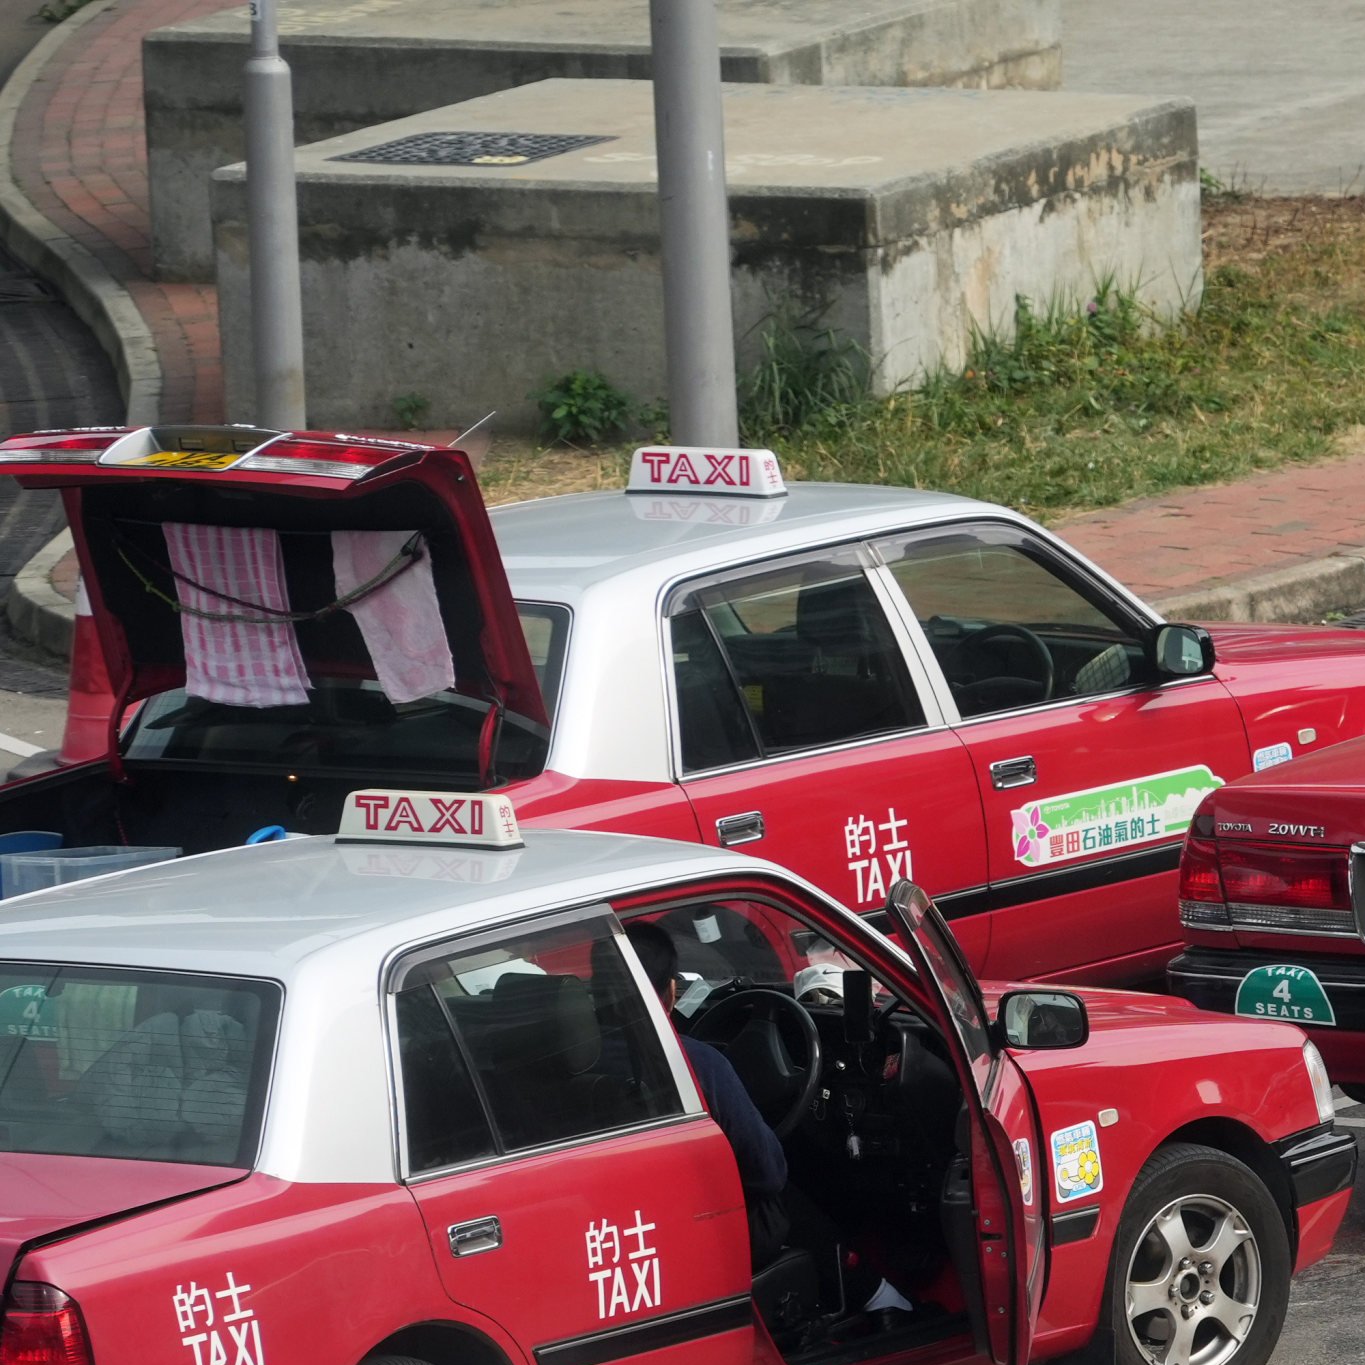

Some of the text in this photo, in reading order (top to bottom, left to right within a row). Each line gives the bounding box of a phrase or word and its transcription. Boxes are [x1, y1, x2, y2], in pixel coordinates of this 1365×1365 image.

[641, 452, 750, 487] TAXI
[354, 795, 483, 835] TAXI
[499, 805, 515, 835] 的士
[1218, 822, 1252, 833] TOYOTA
[844, 807, 909, 859] 的士
[848, 850, 914, 904] TAXI
[1265, 966, 1309, 981] TAXI
[13, 987, 46, 999] TAX
[1273, 980, 1292, 1003] 4
[24, 1000, 37, 1019] 4
[1254, 1002, 1314, 1019] SEATS
[585, 1209, 656, 1269] 的士
[172, 1271, 254, 1333] 的士
[588, 1257, 662, 1320] TAXI
